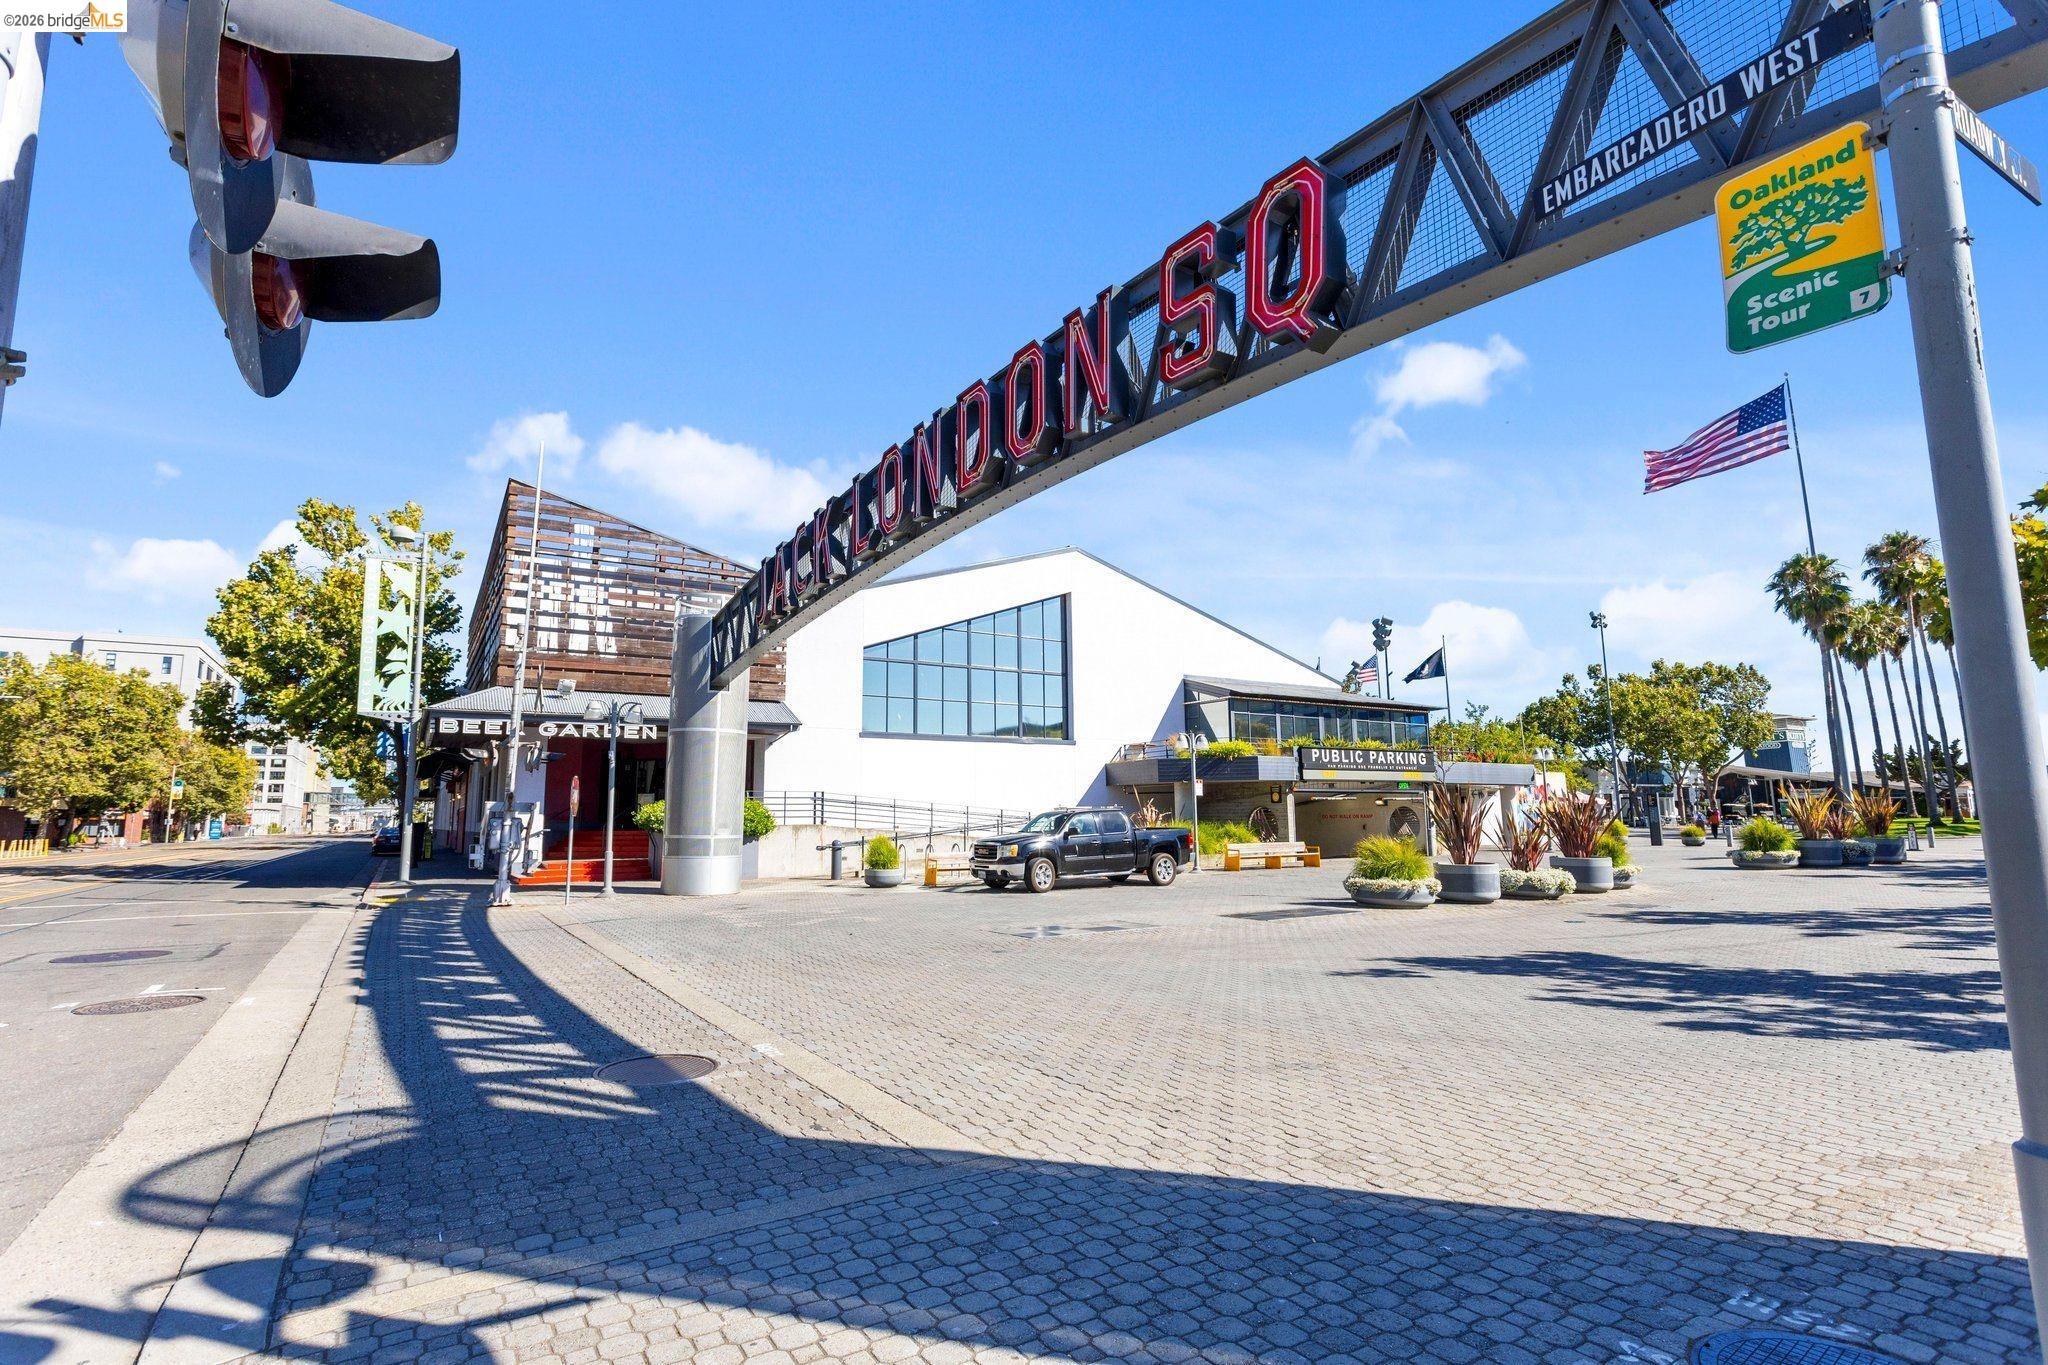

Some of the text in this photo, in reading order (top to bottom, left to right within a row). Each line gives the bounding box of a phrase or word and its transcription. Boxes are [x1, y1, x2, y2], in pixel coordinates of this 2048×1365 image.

[1542, 27, 1821, 213] EMBARCADERO WEST
[1729, 139, 1857, 210] Oakland
[1747, 270, 1840, 316] Scenic
[1860, 291, 1870, 304] 7
[1747, 302, 1811, 335] Tour
[756, 498, 838, 626] JACK
[852, 286, 1116, 557] LONDON
[1159, 156, 1334, 390] SQ
[538, 722, 658, 740] GARDEN
[1311, 749, 1427, 765] PUBLIC PARKING
